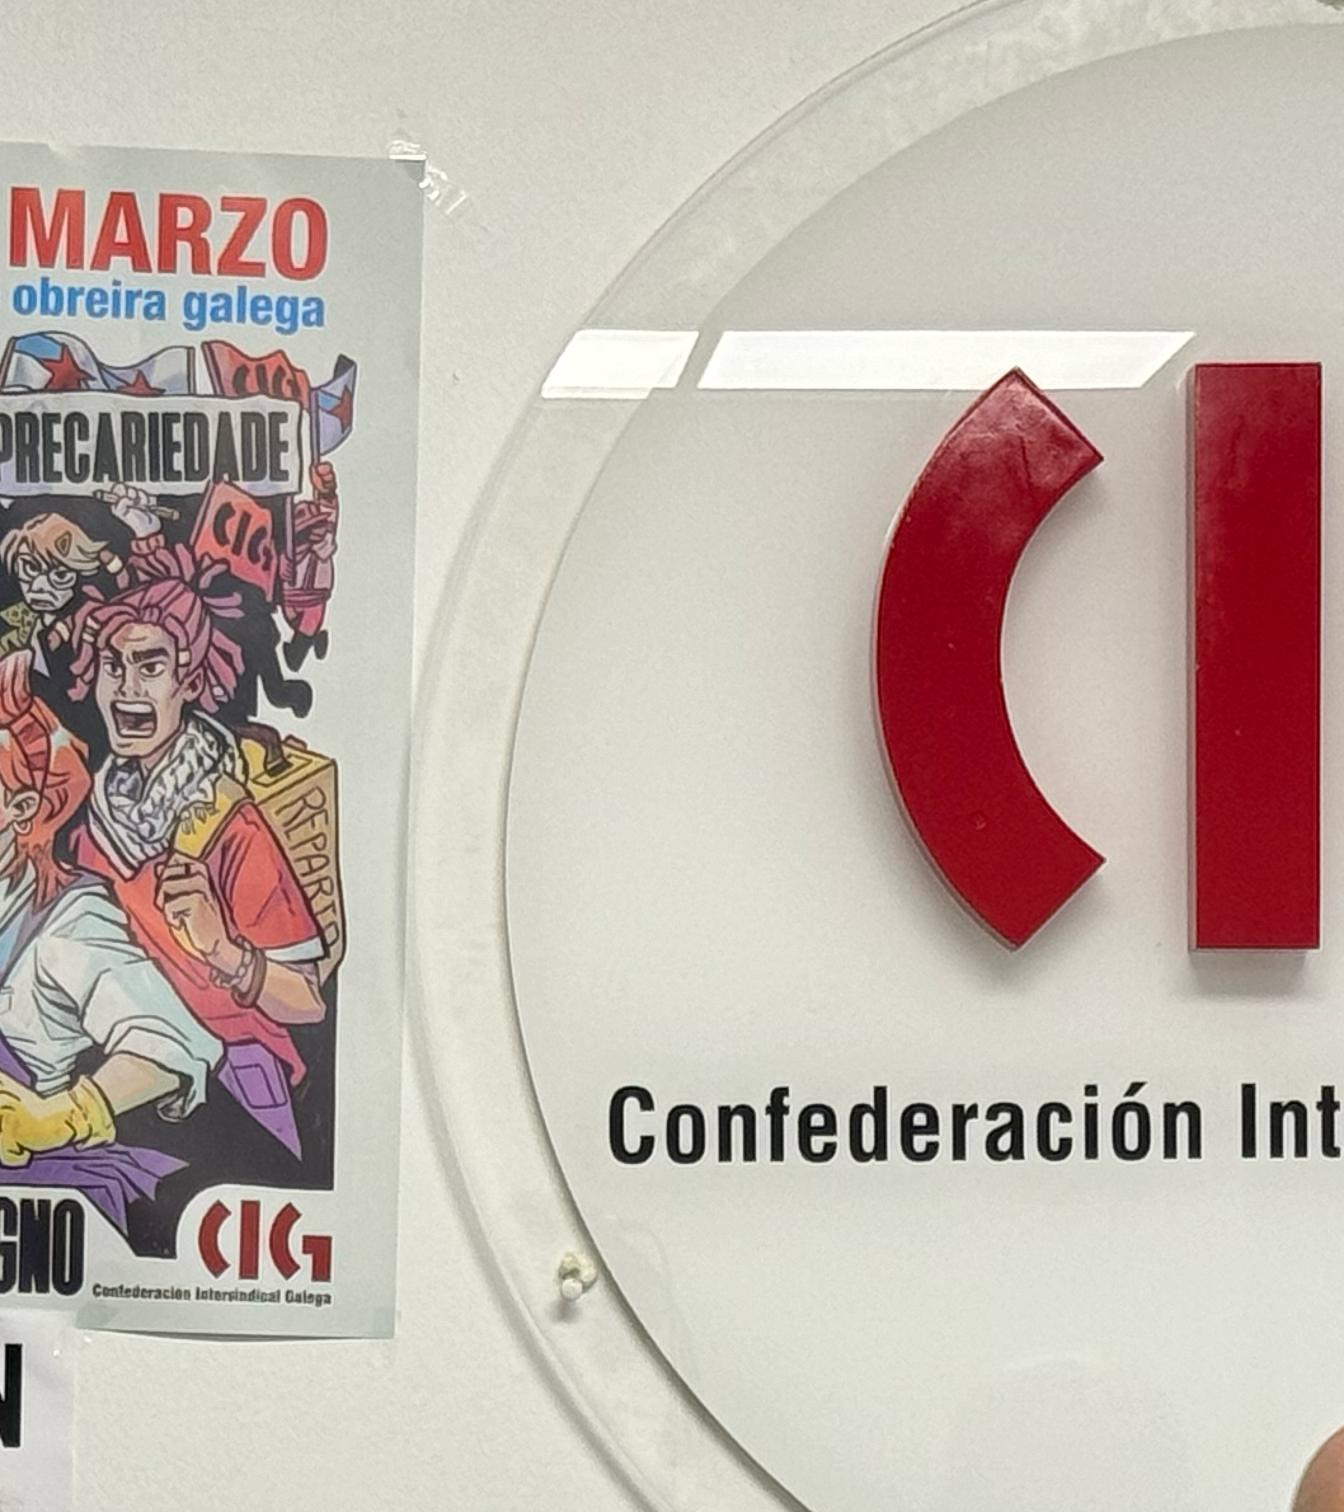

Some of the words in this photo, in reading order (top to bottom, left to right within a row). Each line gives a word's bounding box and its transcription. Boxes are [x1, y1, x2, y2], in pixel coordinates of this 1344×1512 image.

[10, 187, 328, 281] MARZO
[13, 278, 166, 321] obreira
[183, 283, 326, 331] galega
[608, 1080, 1204, 1165] Confederación
[198, 1200, 332, 1282] CIG
[196, 1286, 281, 1303] Intersindical
